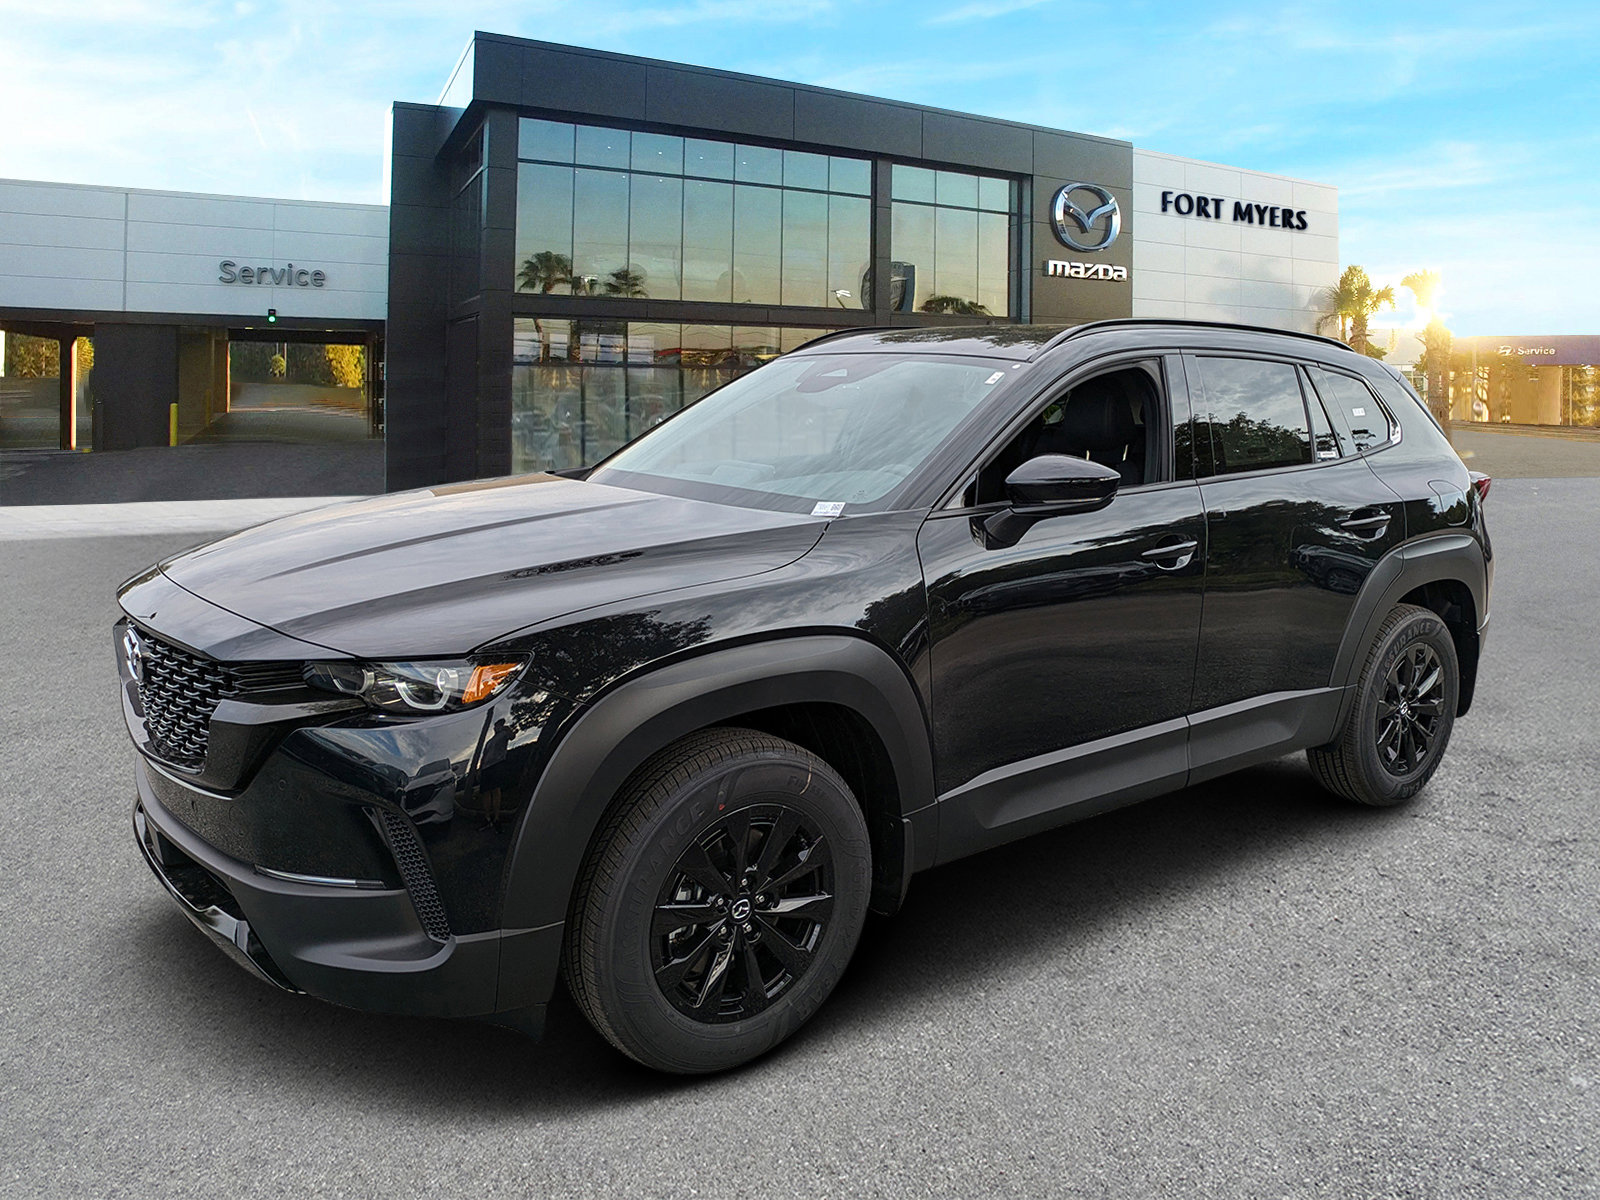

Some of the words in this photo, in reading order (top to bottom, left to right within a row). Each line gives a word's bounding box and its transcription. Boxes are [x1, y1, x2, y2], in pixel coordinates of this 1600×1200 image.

[1161, 191, 1225, 219] FORT
[1233, 201, 1309, 230] MYERS
[218, 260, 326, 287] Service
[1517, 346, 1556, 355] Service
